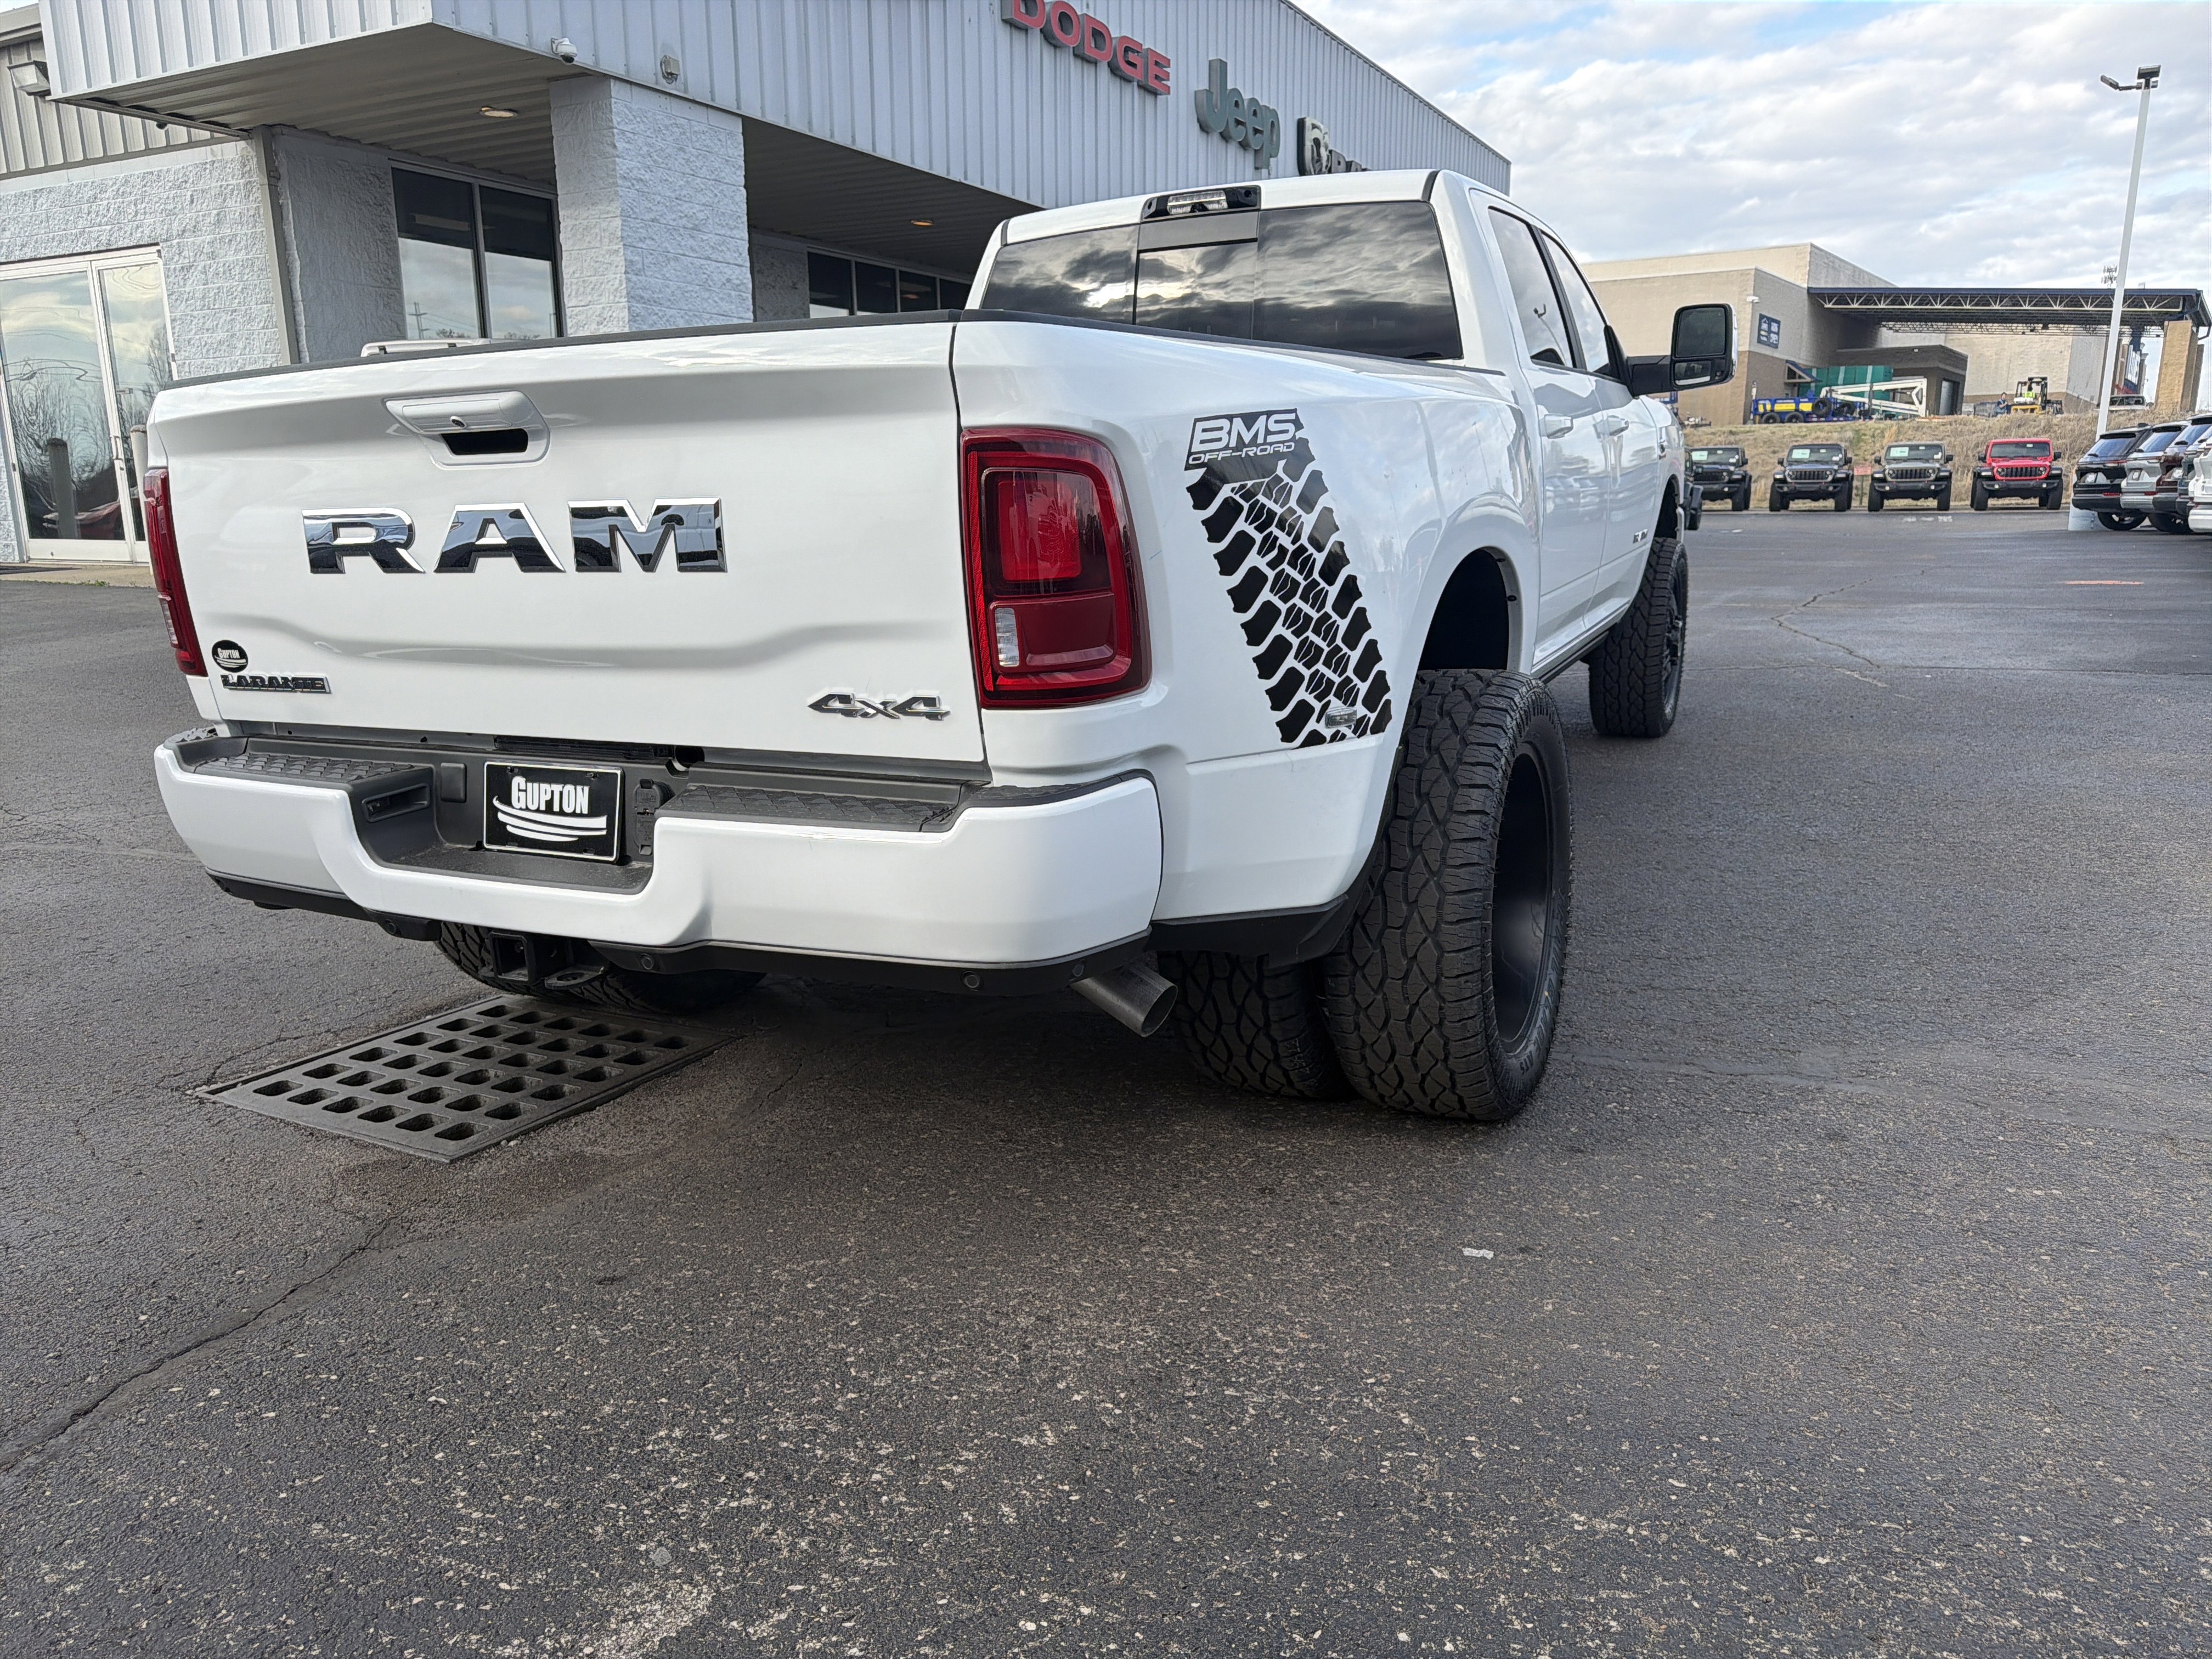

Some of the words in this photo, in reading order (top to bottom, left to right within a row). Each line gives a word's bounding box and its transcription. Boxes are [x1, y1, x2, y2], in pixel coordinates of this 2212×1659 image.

[1001, 0, 1171, 96] DODGE
[1194, 58, 1280, 170] Jeep
[1188, 442, 1295, 464] OFF-ROAD
[1191, 413, 1296, 452] BMS
[302, 497, 727, 574] RAM
[511, 775, 590, 814] GUPTON
